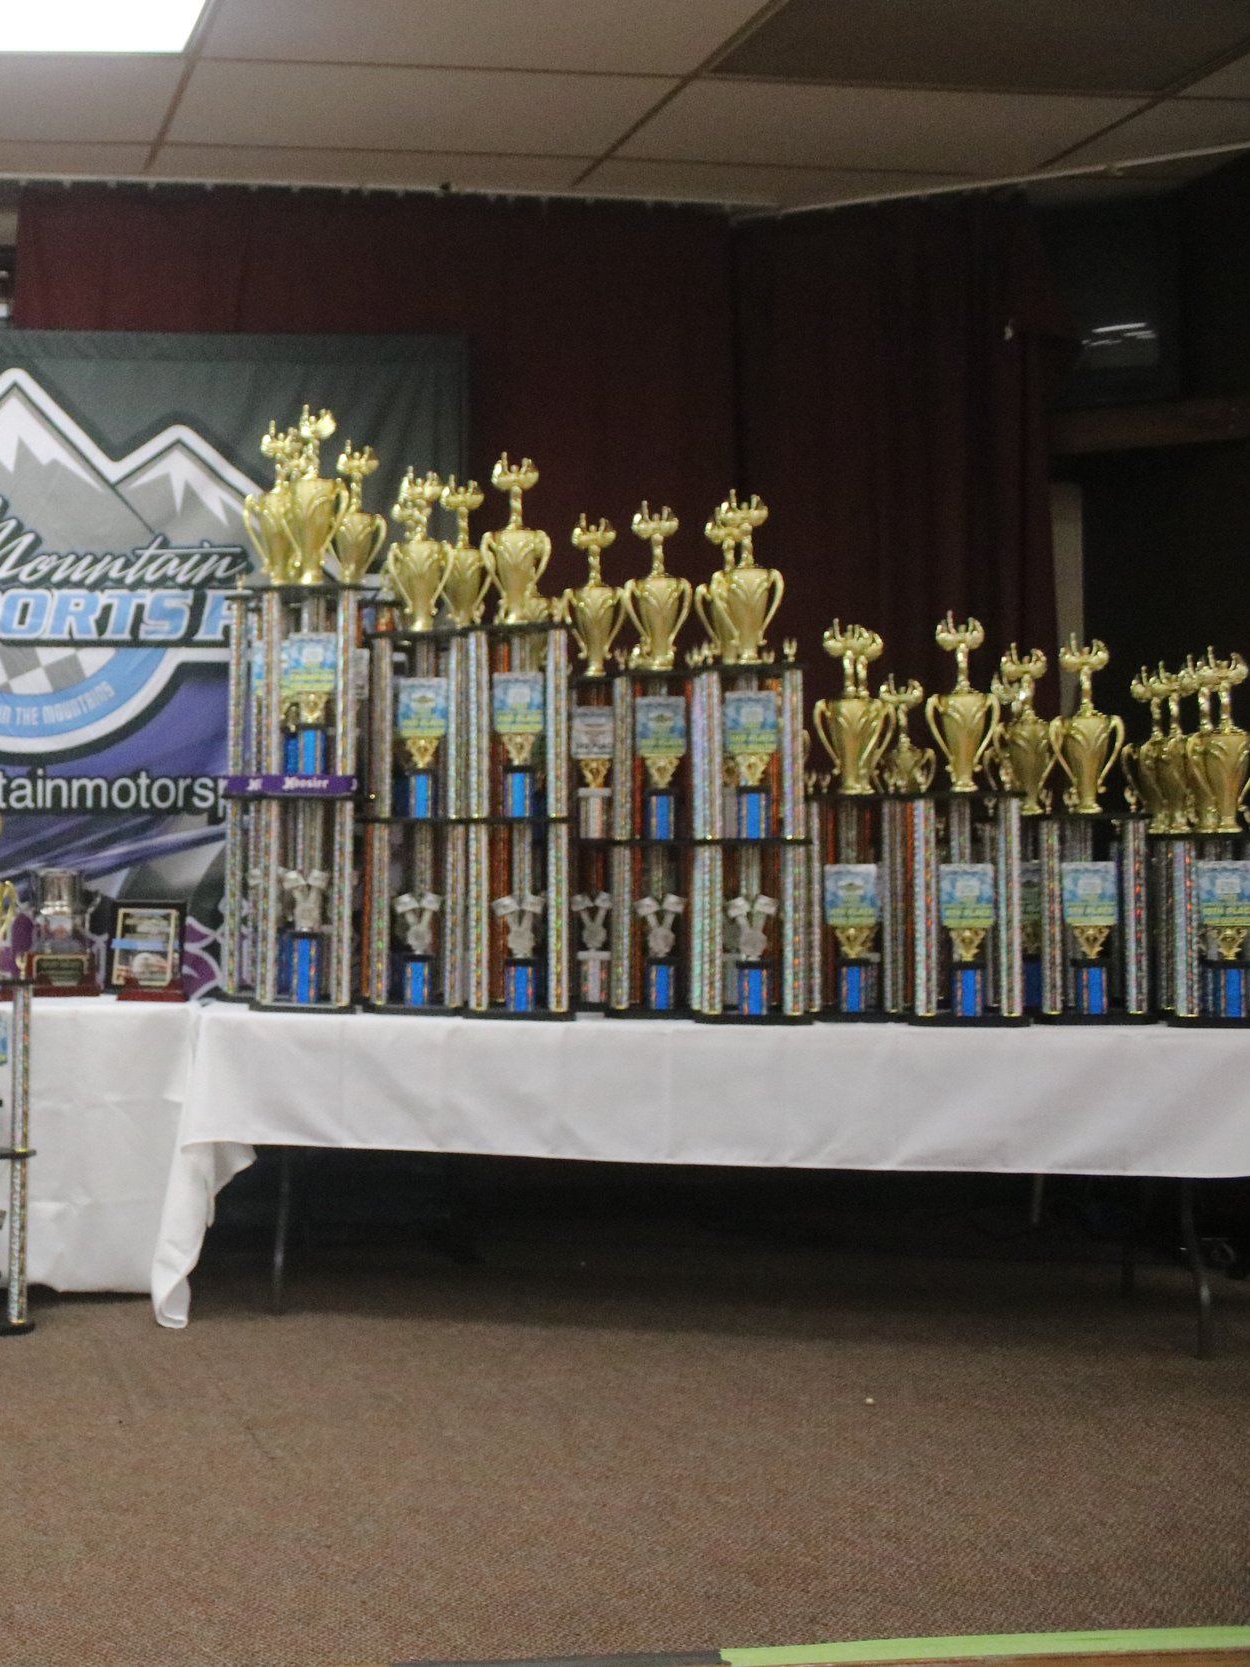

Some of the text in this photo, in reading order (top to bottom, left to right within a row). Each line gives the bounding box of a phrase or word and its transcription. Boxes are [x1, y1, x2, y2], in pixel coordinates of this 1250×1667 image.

[15, 706, 40, 727] THE
[41, 680, 116, 726] MOUNTAINS
[282, 776, 329, 791] Hoosier
